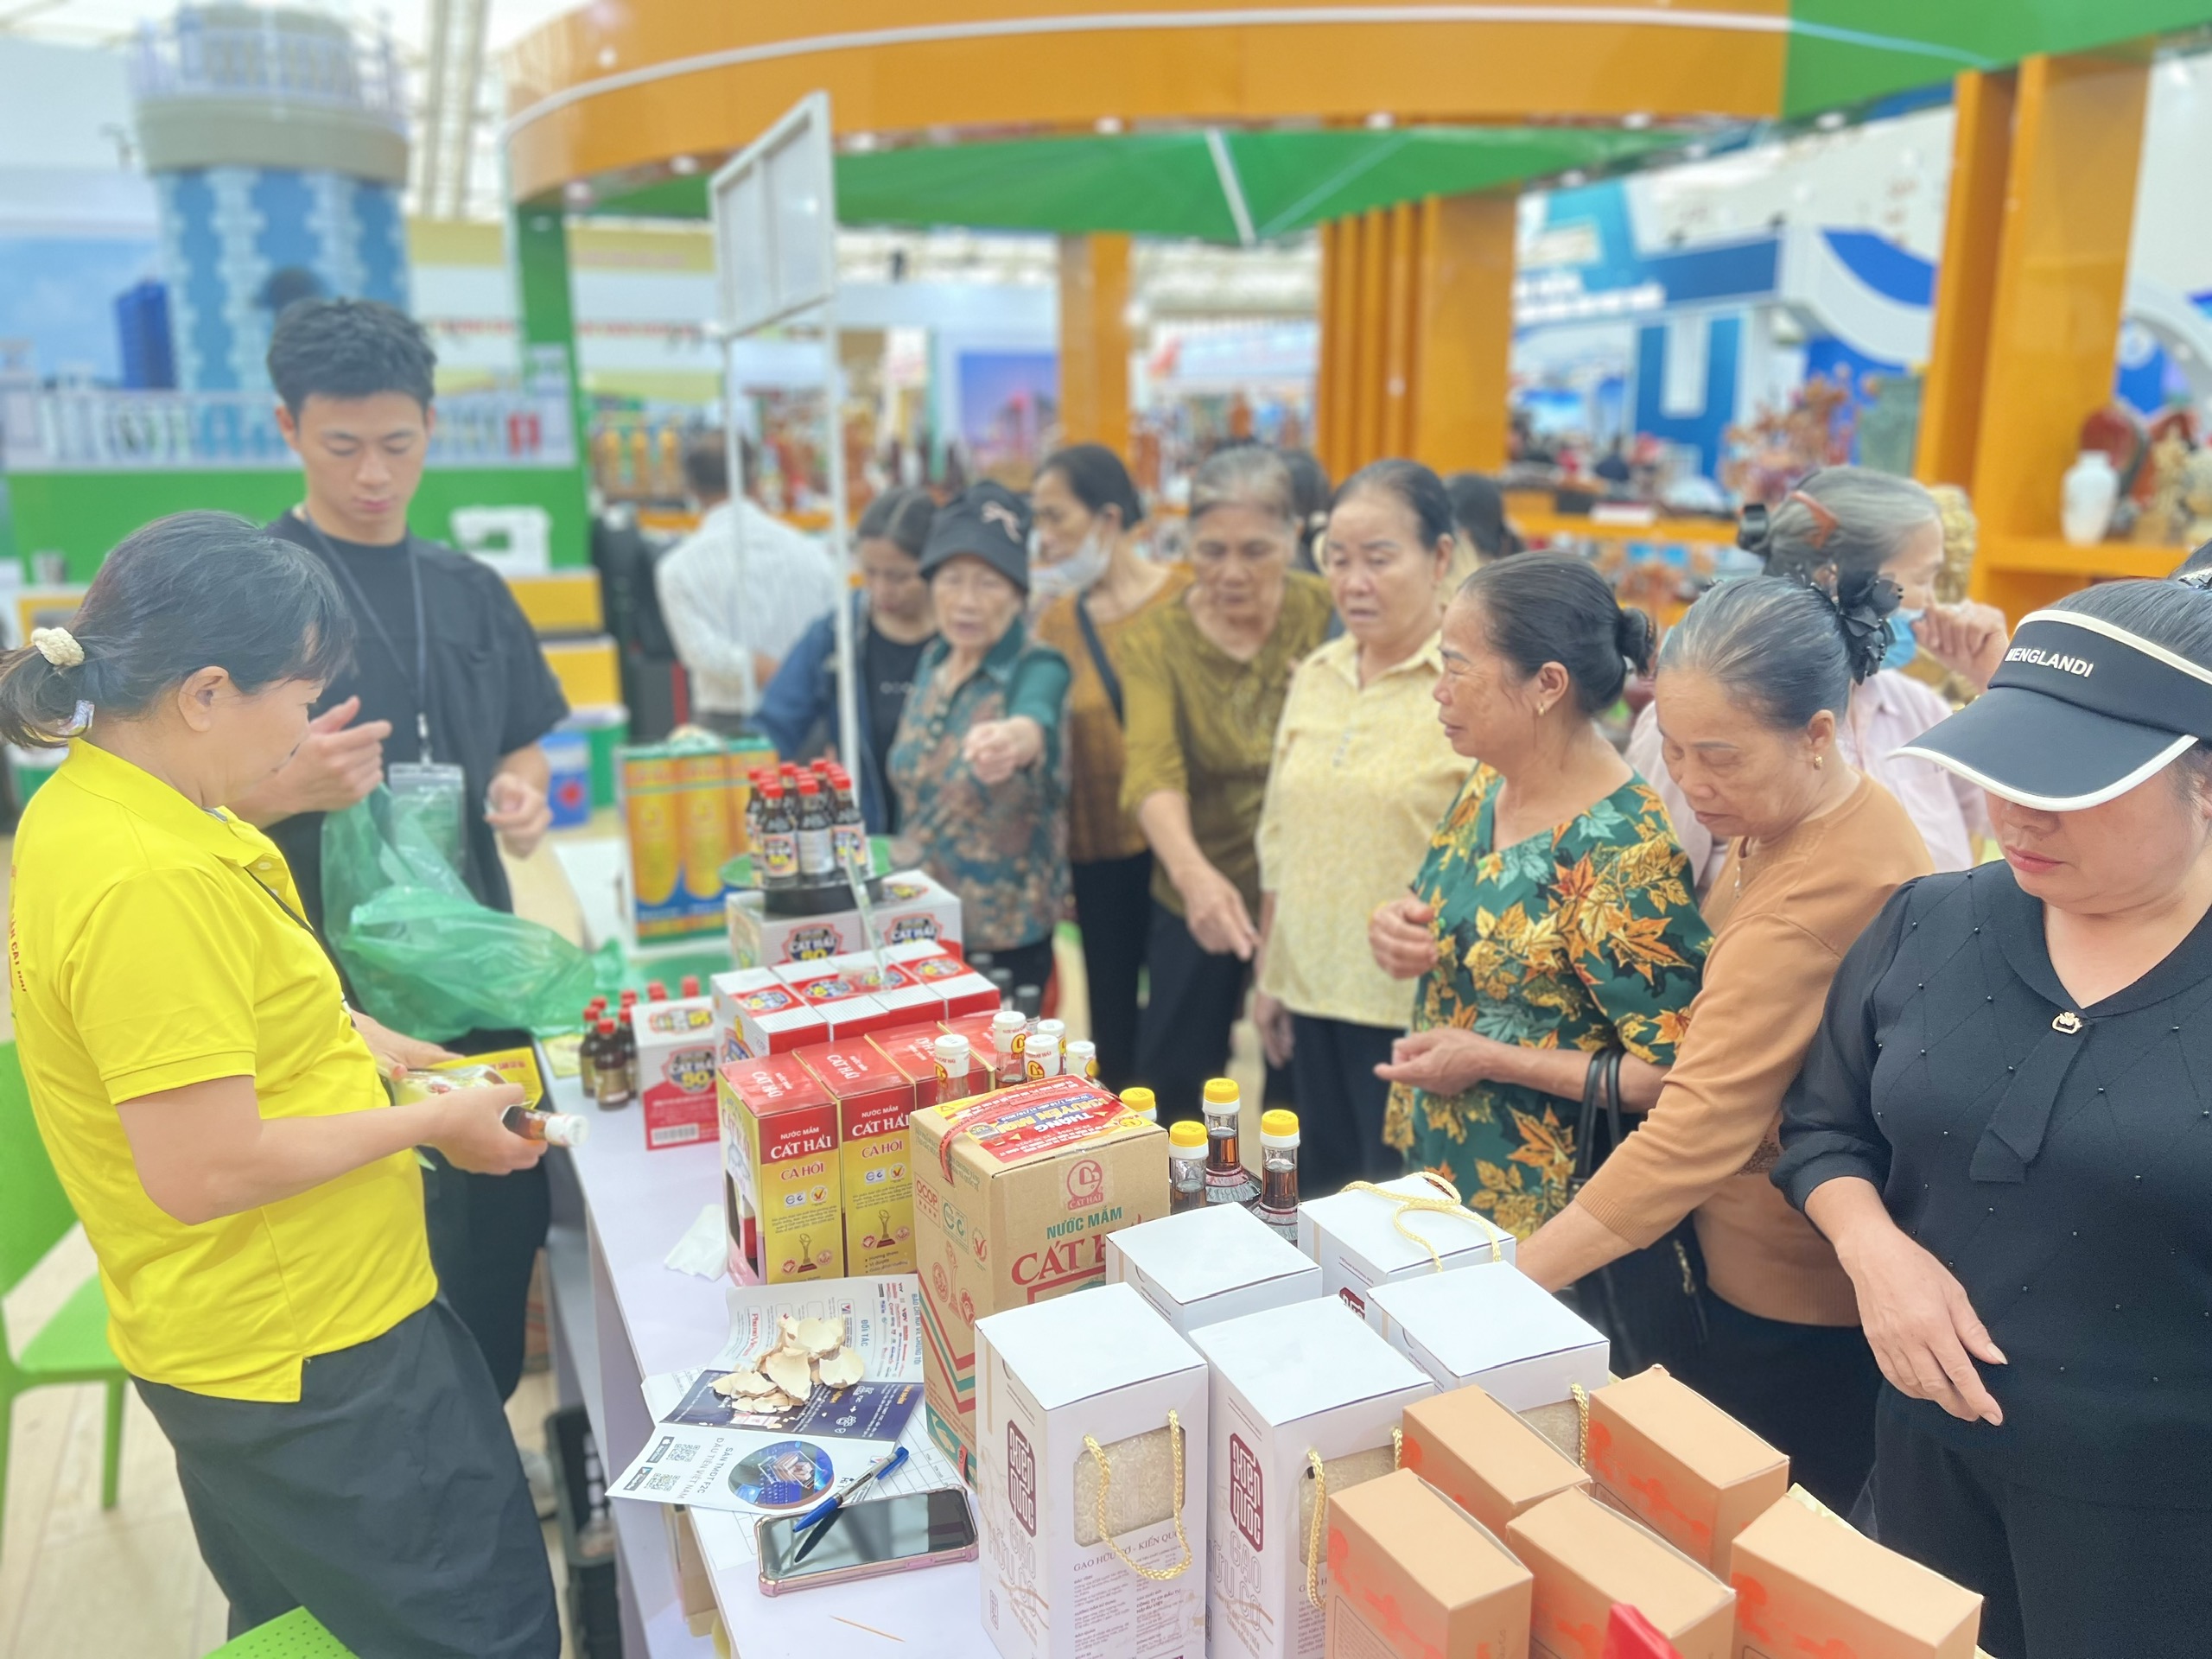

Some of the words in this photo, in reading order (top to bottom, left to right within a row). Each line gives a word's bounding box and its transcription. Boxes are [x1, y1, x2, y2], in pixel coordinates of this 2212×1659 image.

[861, 1109, 882, 1118] NƯỚC
[1036, 1098, 1109, 1121] KHUYẾN
[780, 1130, 801, 1140] NƯỚC
[803, 1126, 820, 1135] MẮM
[852, 1120, 881, 1137] CÁT
[1034, 1112, 1094, 1133] THÁNG
[770, 1142, 801, 1159] CÁT
[803, 1134, 832, 1152] HẢI
[916, 1180, 938, 1205] OCOP
[1047, 1217, 1084, 1239] NƯỚC
[1087, 1205, 1122, 1228] MẮM
[1011, 1238, 1085, 1285] CÁT
[861, 1334, 870, 1347] TÁC
[1138, 1535, 1160, 1551] KIẾN
